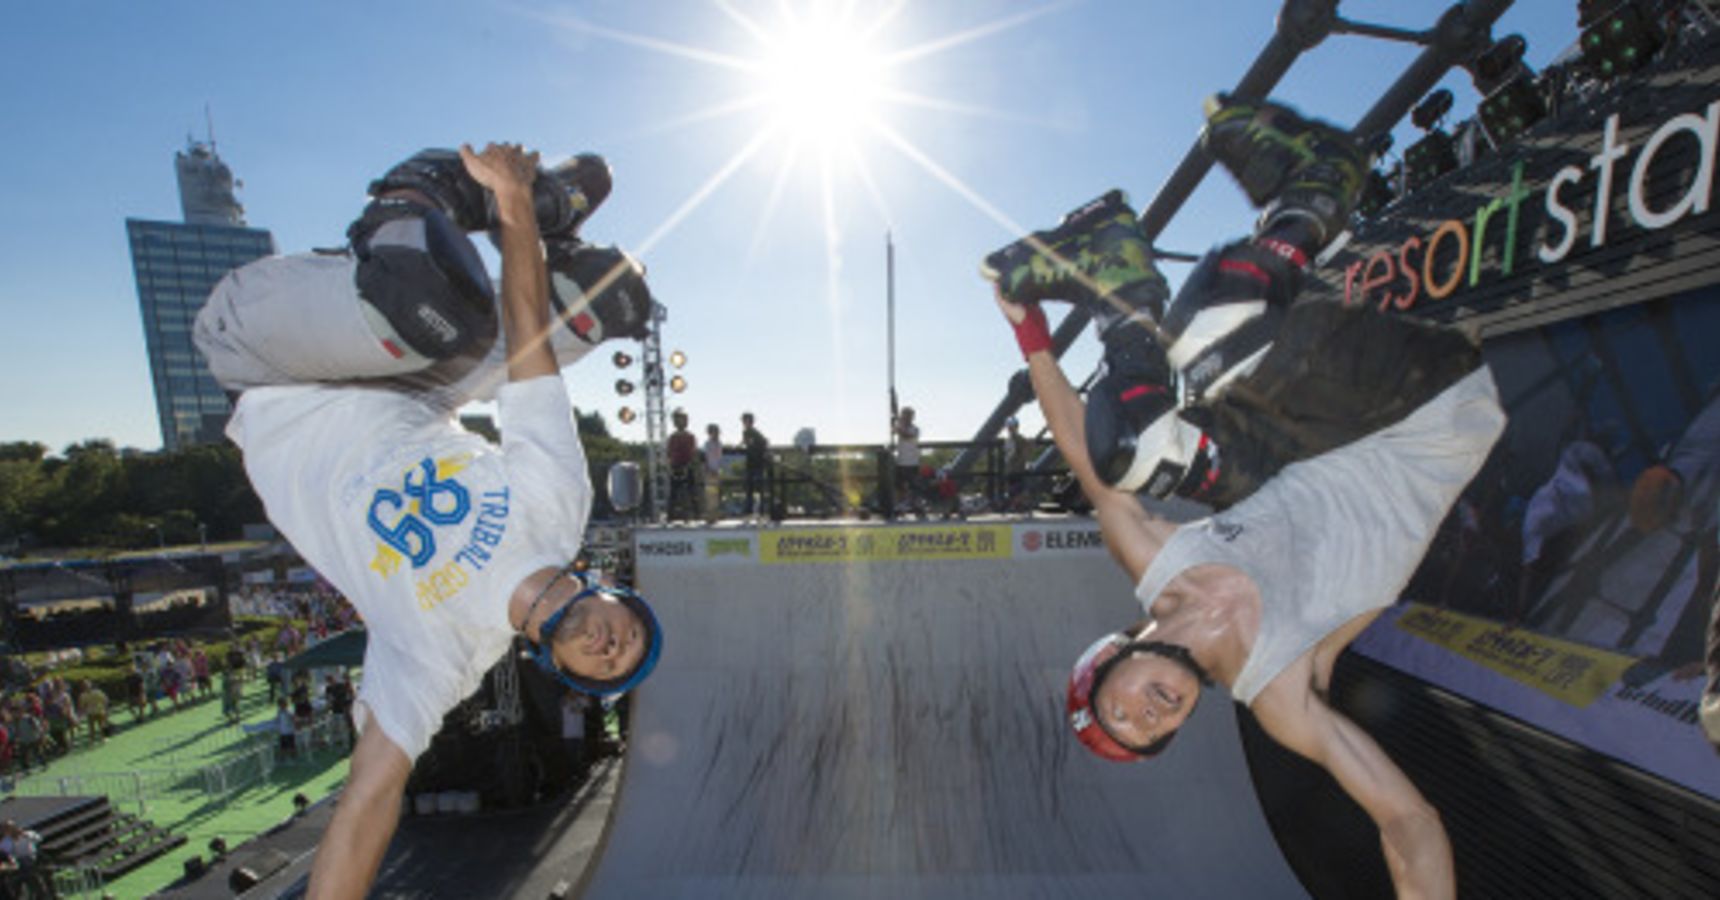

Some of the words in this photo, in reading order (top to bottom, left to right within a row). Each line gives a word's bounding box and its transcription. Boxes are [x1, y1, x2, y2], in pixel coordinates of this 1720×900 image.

[1344, 159, 1532, 312] resort
[1538, 99, 1720, 263] sta
[367, 457, 471, 569] 89
[454, 486, 509, 570] TRIBAL
